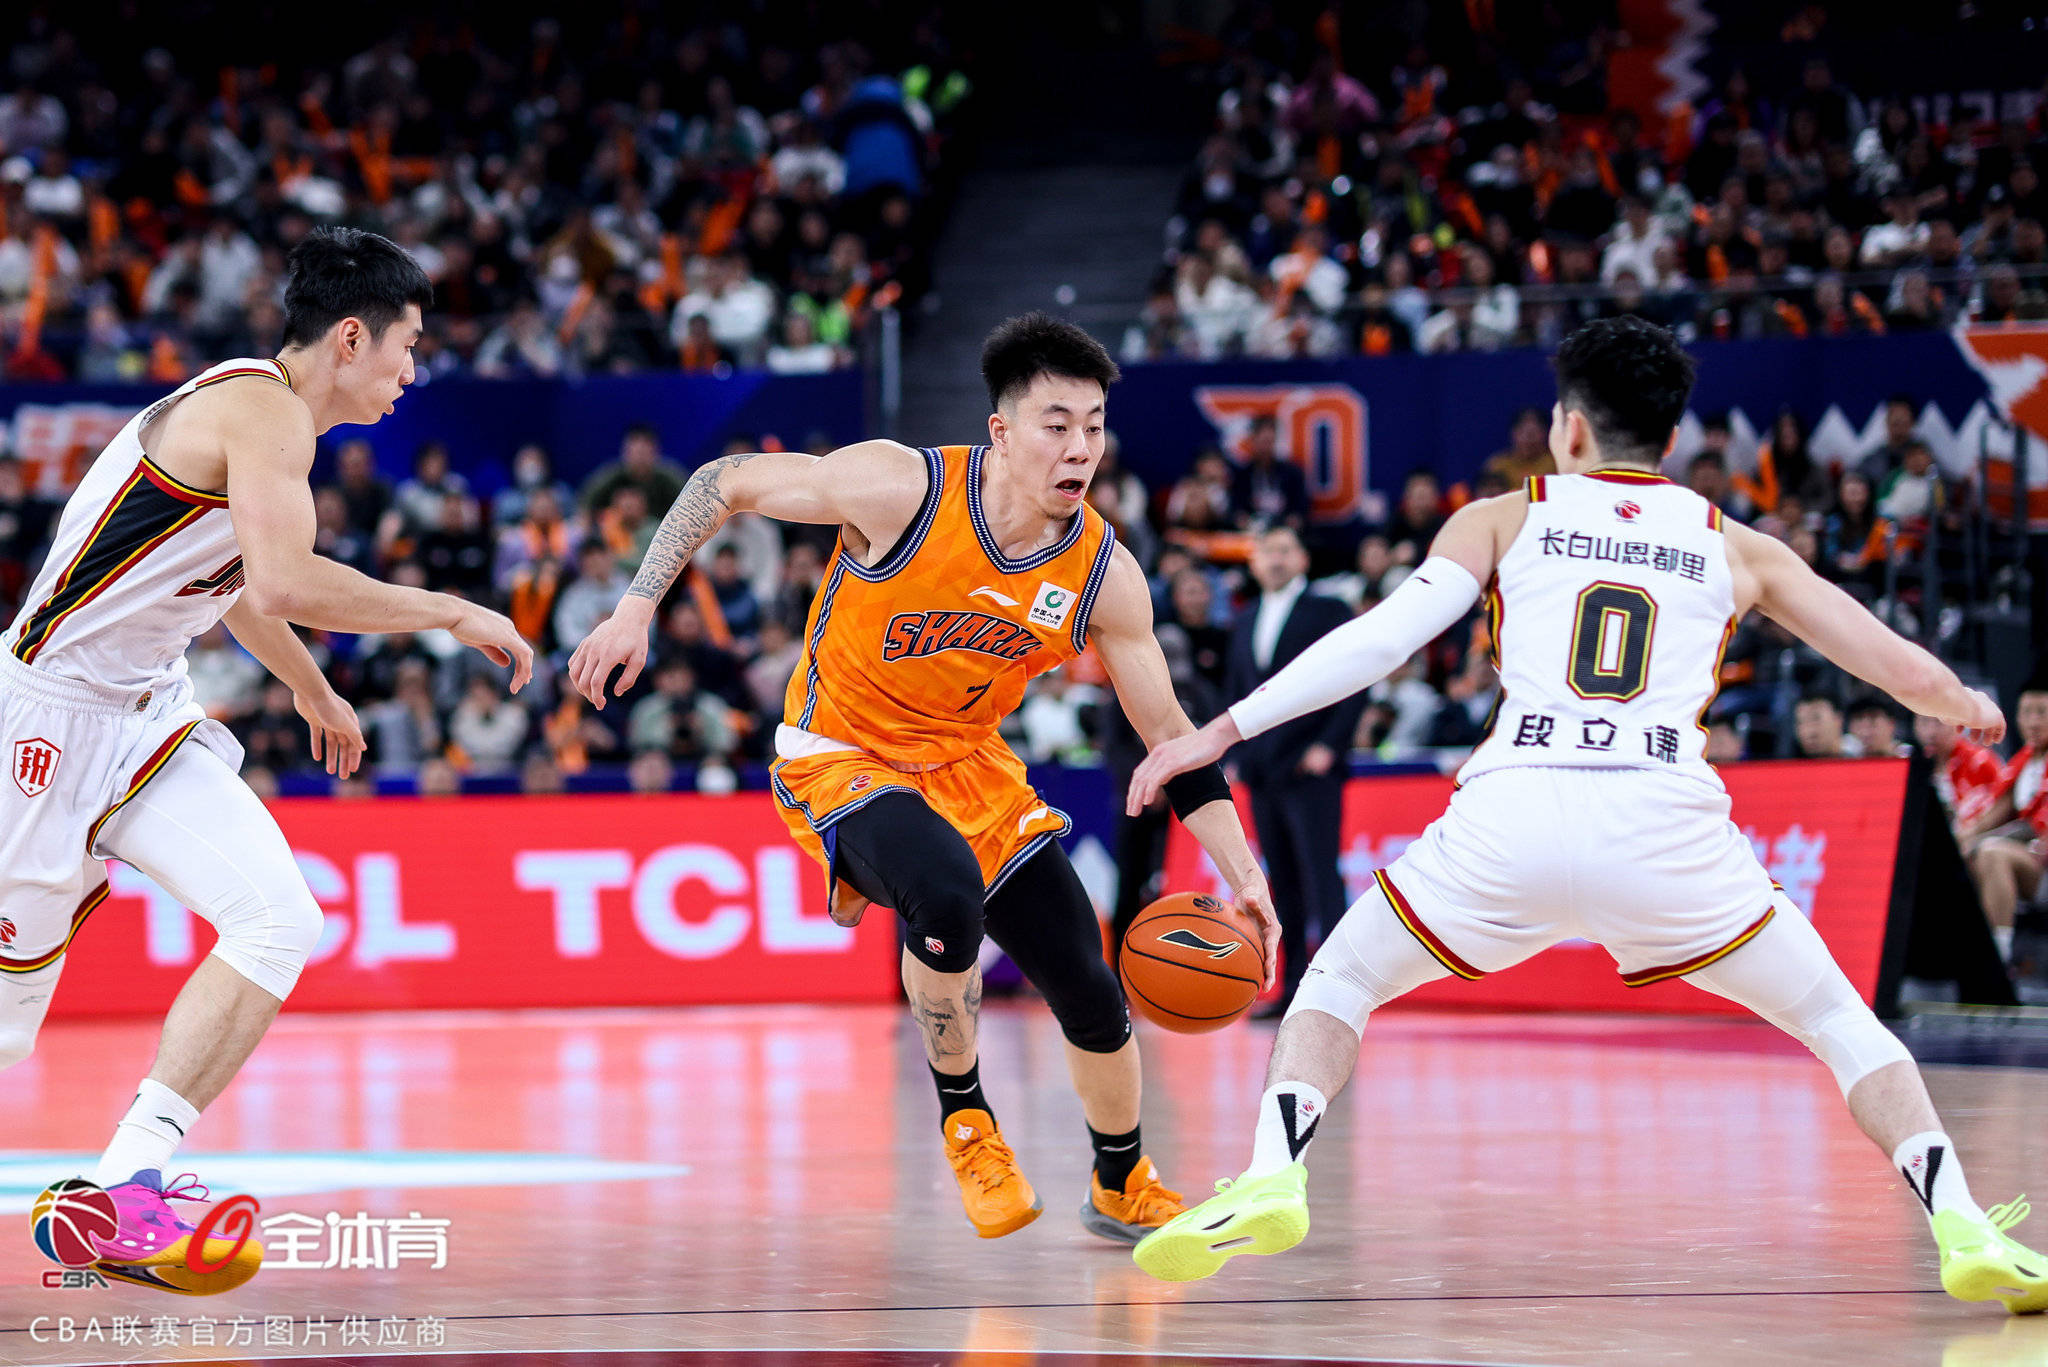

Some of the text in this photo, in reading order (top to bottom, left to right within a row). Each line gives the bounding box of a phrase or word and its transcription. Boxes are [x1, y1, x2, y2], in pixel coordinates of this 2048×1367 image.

[1539, 527, 1706, 583] 长白山恩都里
[1566, 580, 1658, 703] 0
[956, 678, 994, 713] 7
[514, 843, 854, 959] TCL
[934, 1023, 946, 1036] 7
